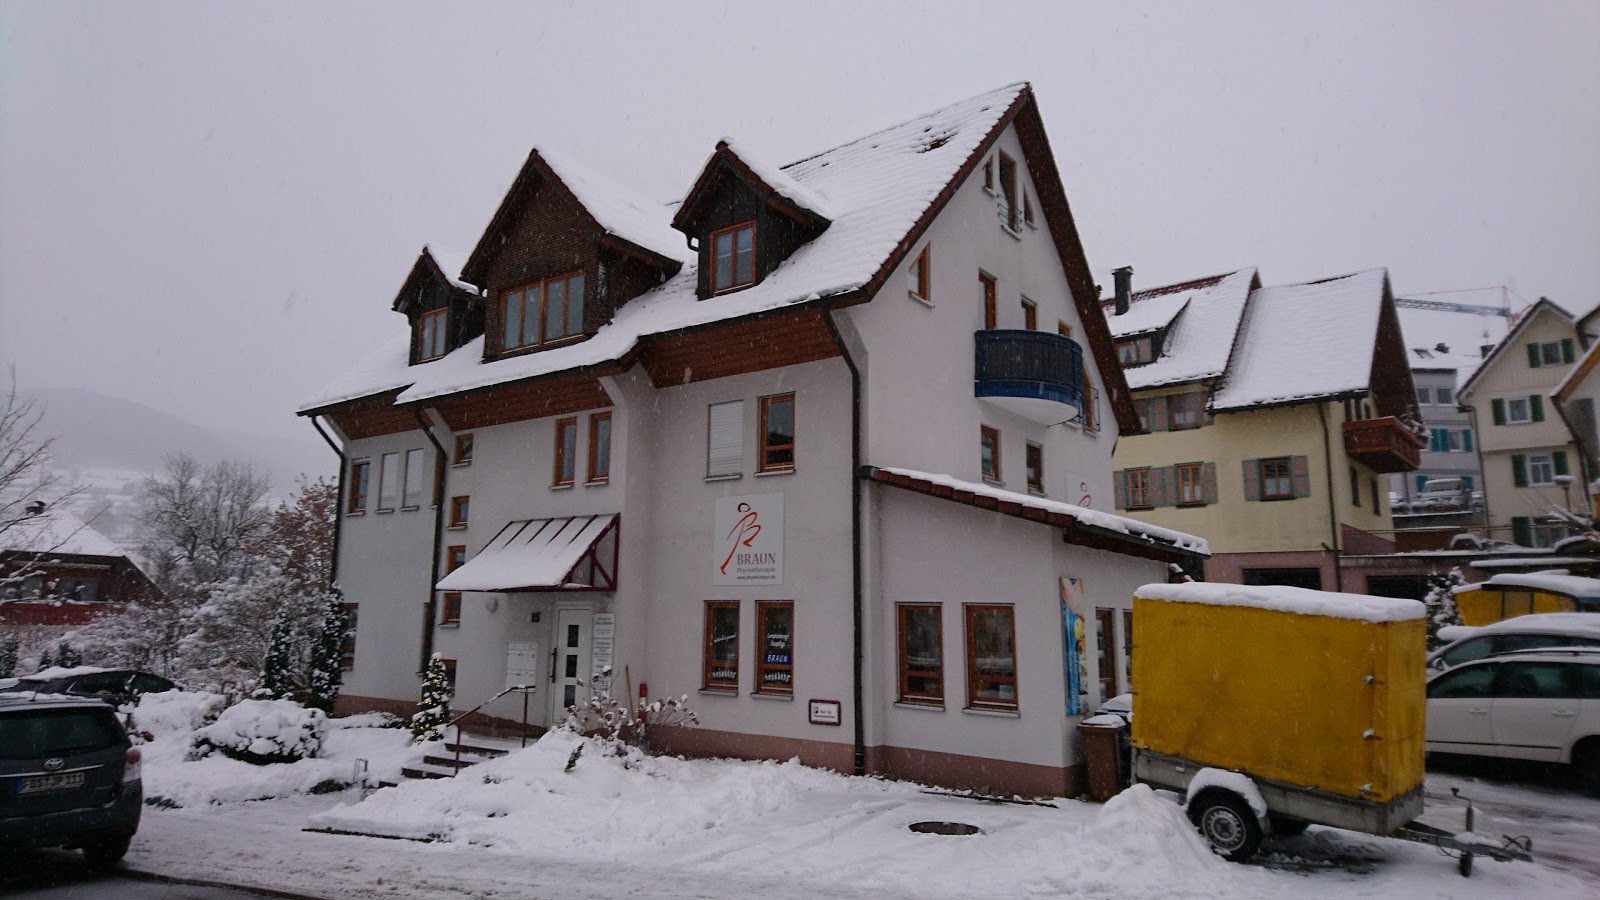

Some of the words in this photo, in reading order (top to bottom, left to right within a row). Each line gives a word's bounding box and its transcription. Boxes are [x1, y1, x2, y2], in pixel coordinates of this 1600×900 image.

[737, 553, 776, 565] BRAUN
[531, 612, 541, 622] 15
[767, 654, 788, 663] BRAUN
